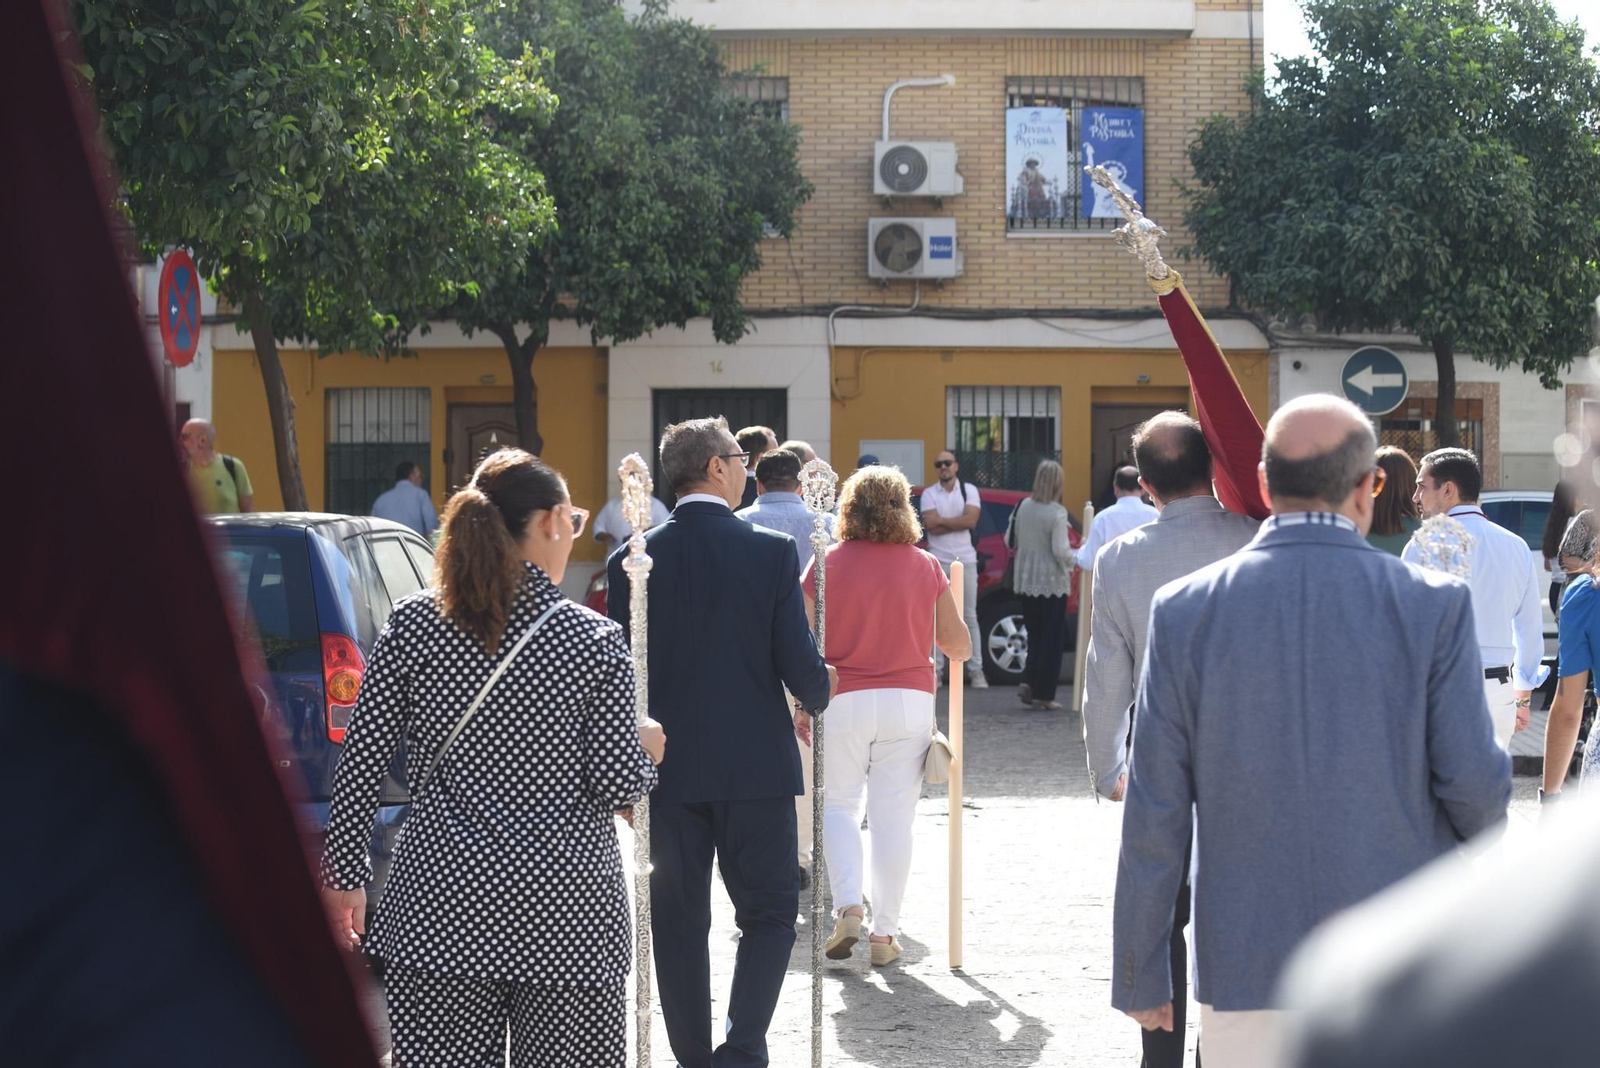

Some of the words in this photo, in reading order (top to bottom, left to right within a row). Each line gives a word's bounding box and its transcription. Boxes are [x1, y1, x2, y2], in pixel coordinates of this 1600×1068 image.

[1018, 123, 1052, 135] DIVINA
[1090, 125, 1135, 140] PASTORA
[1014, 135, 1056, 148] PASTORA
[930, 243, 951, 252] Haier
